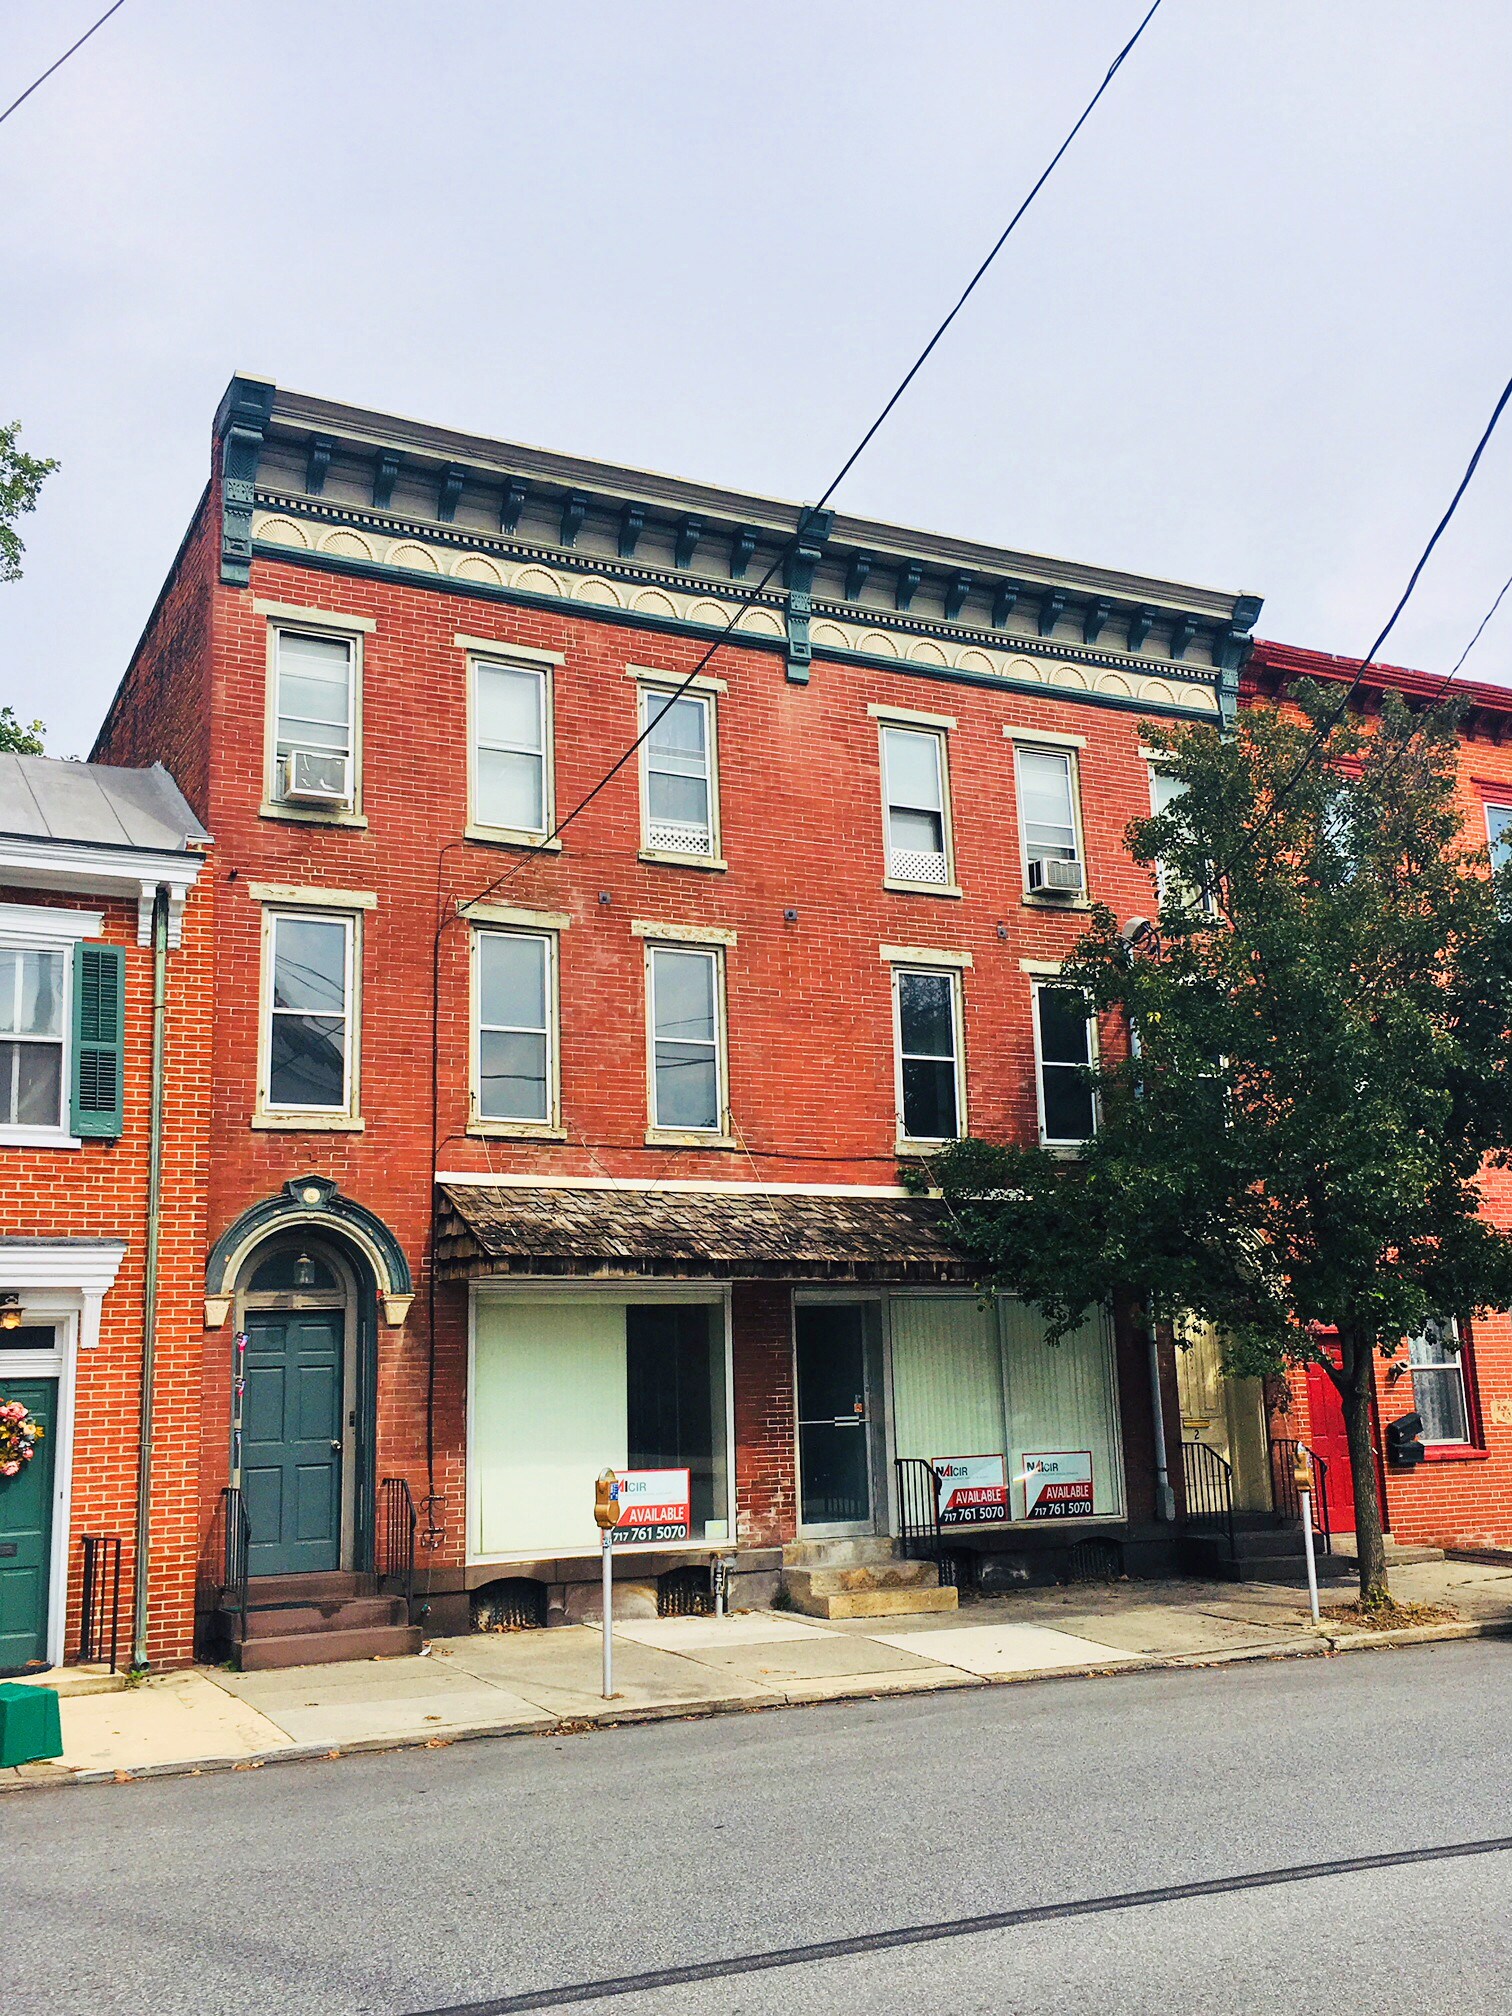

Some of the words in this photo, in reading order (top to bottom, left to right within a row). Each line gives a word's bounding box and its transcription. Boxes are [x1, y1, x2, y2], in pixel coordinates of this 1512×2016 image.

[1194, 1429, 1200, 1440] 2
[955, 1489, 1002, 1504] AVAILABLE
[1046, 1485, 1089, 1499] AVAILABLE
[629, 1506, 684, 1522] AVAILABLE
[944, 1513, 957, 1522] 717
[958, 1508, 976, 1520] 761
[979, 1506, 1004, 1519] 5070
[1034, 1508, 1047, 1516] 717
[1048, 1503, 1065, 1515] 761
[1068, 1501, 1091, 1514] 5070
[613, 1532, 629, 1542] 717
[631, 1527, 652, 1540] 761
[656, 1525, 686, 1539] 5070
